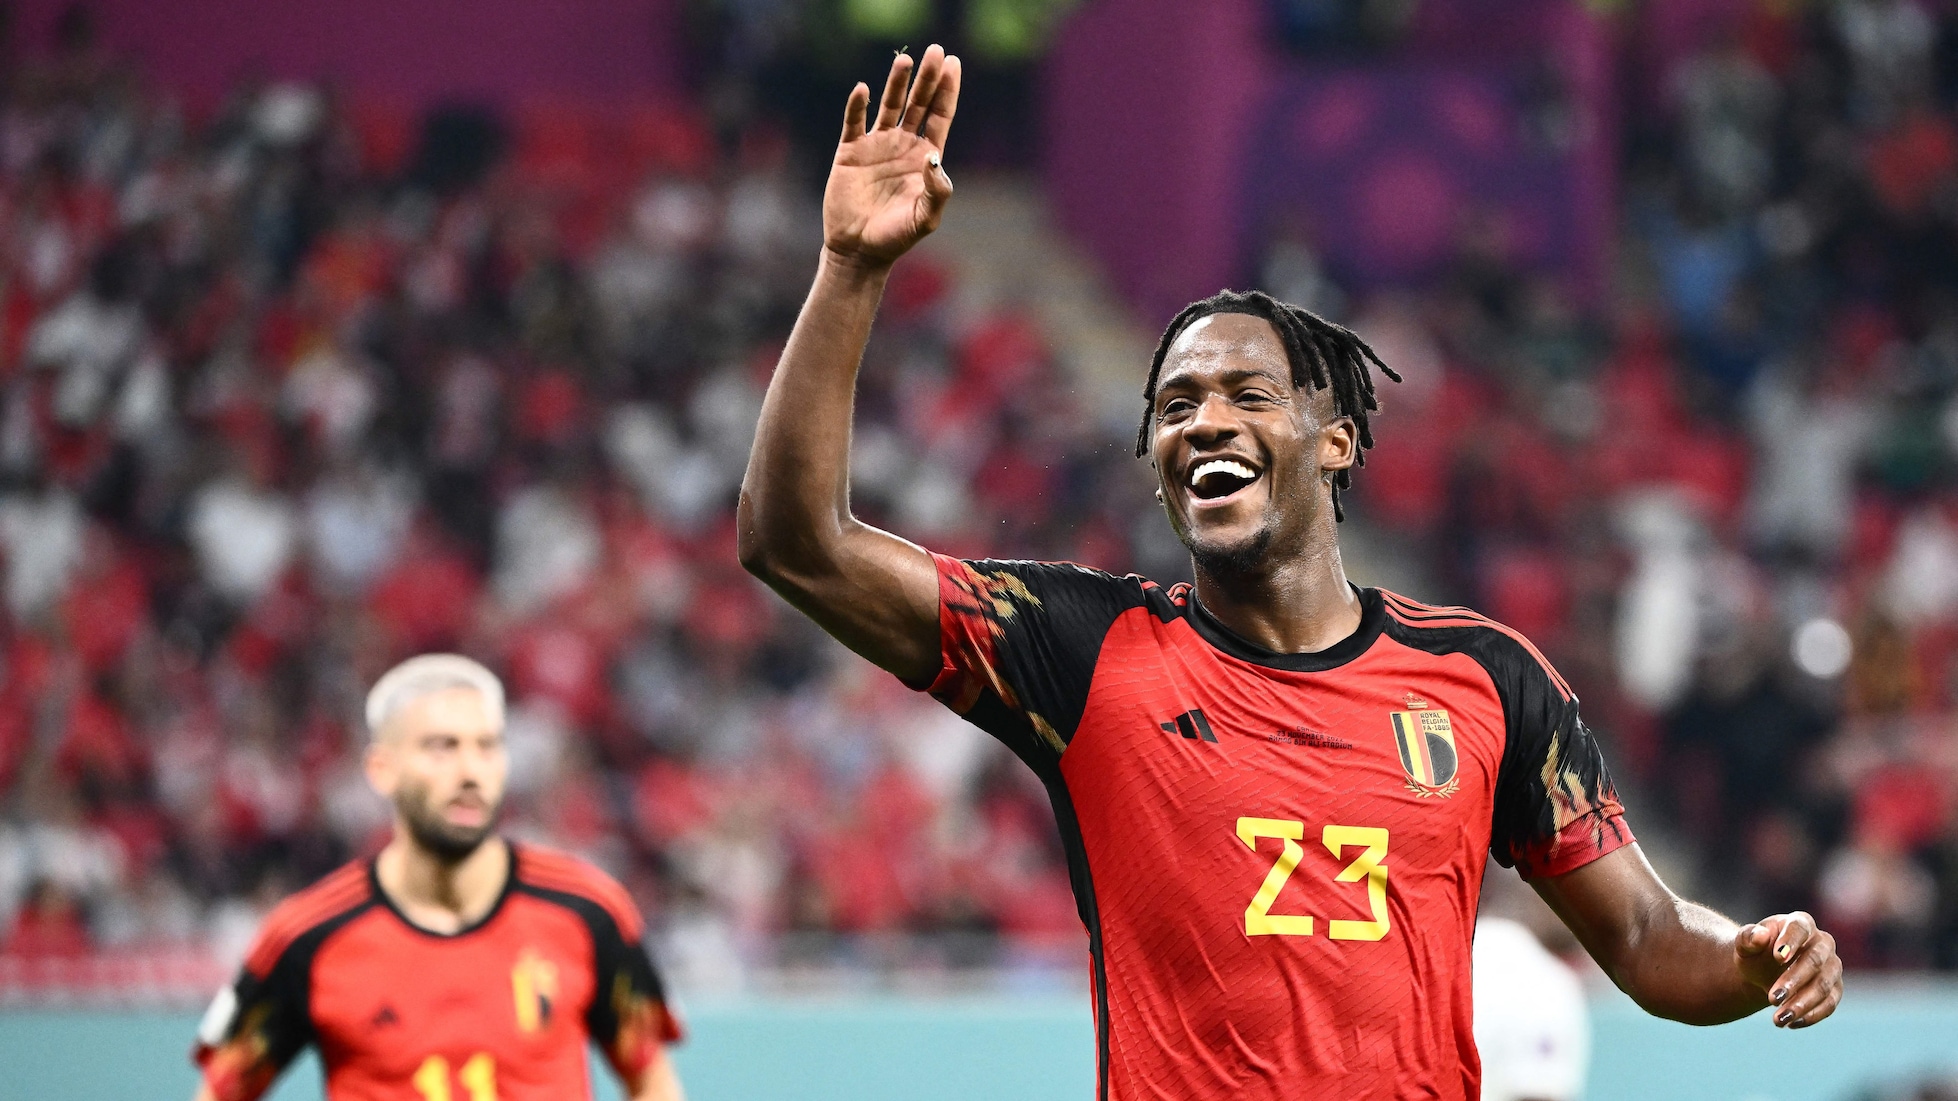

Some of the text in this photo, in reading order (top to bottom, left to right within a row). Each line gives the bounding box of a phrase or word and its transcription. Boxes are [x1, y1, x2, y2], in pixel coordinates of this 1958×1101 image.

[1287, 731, 1325, 740] NOVEMBER
[1294, 738, 1306, 746] BIN
[1322, 741, 1353, 750] STADIUM
[1235, 816, 1391, 942] 23
[412, 1053, 497, 1101] 11
